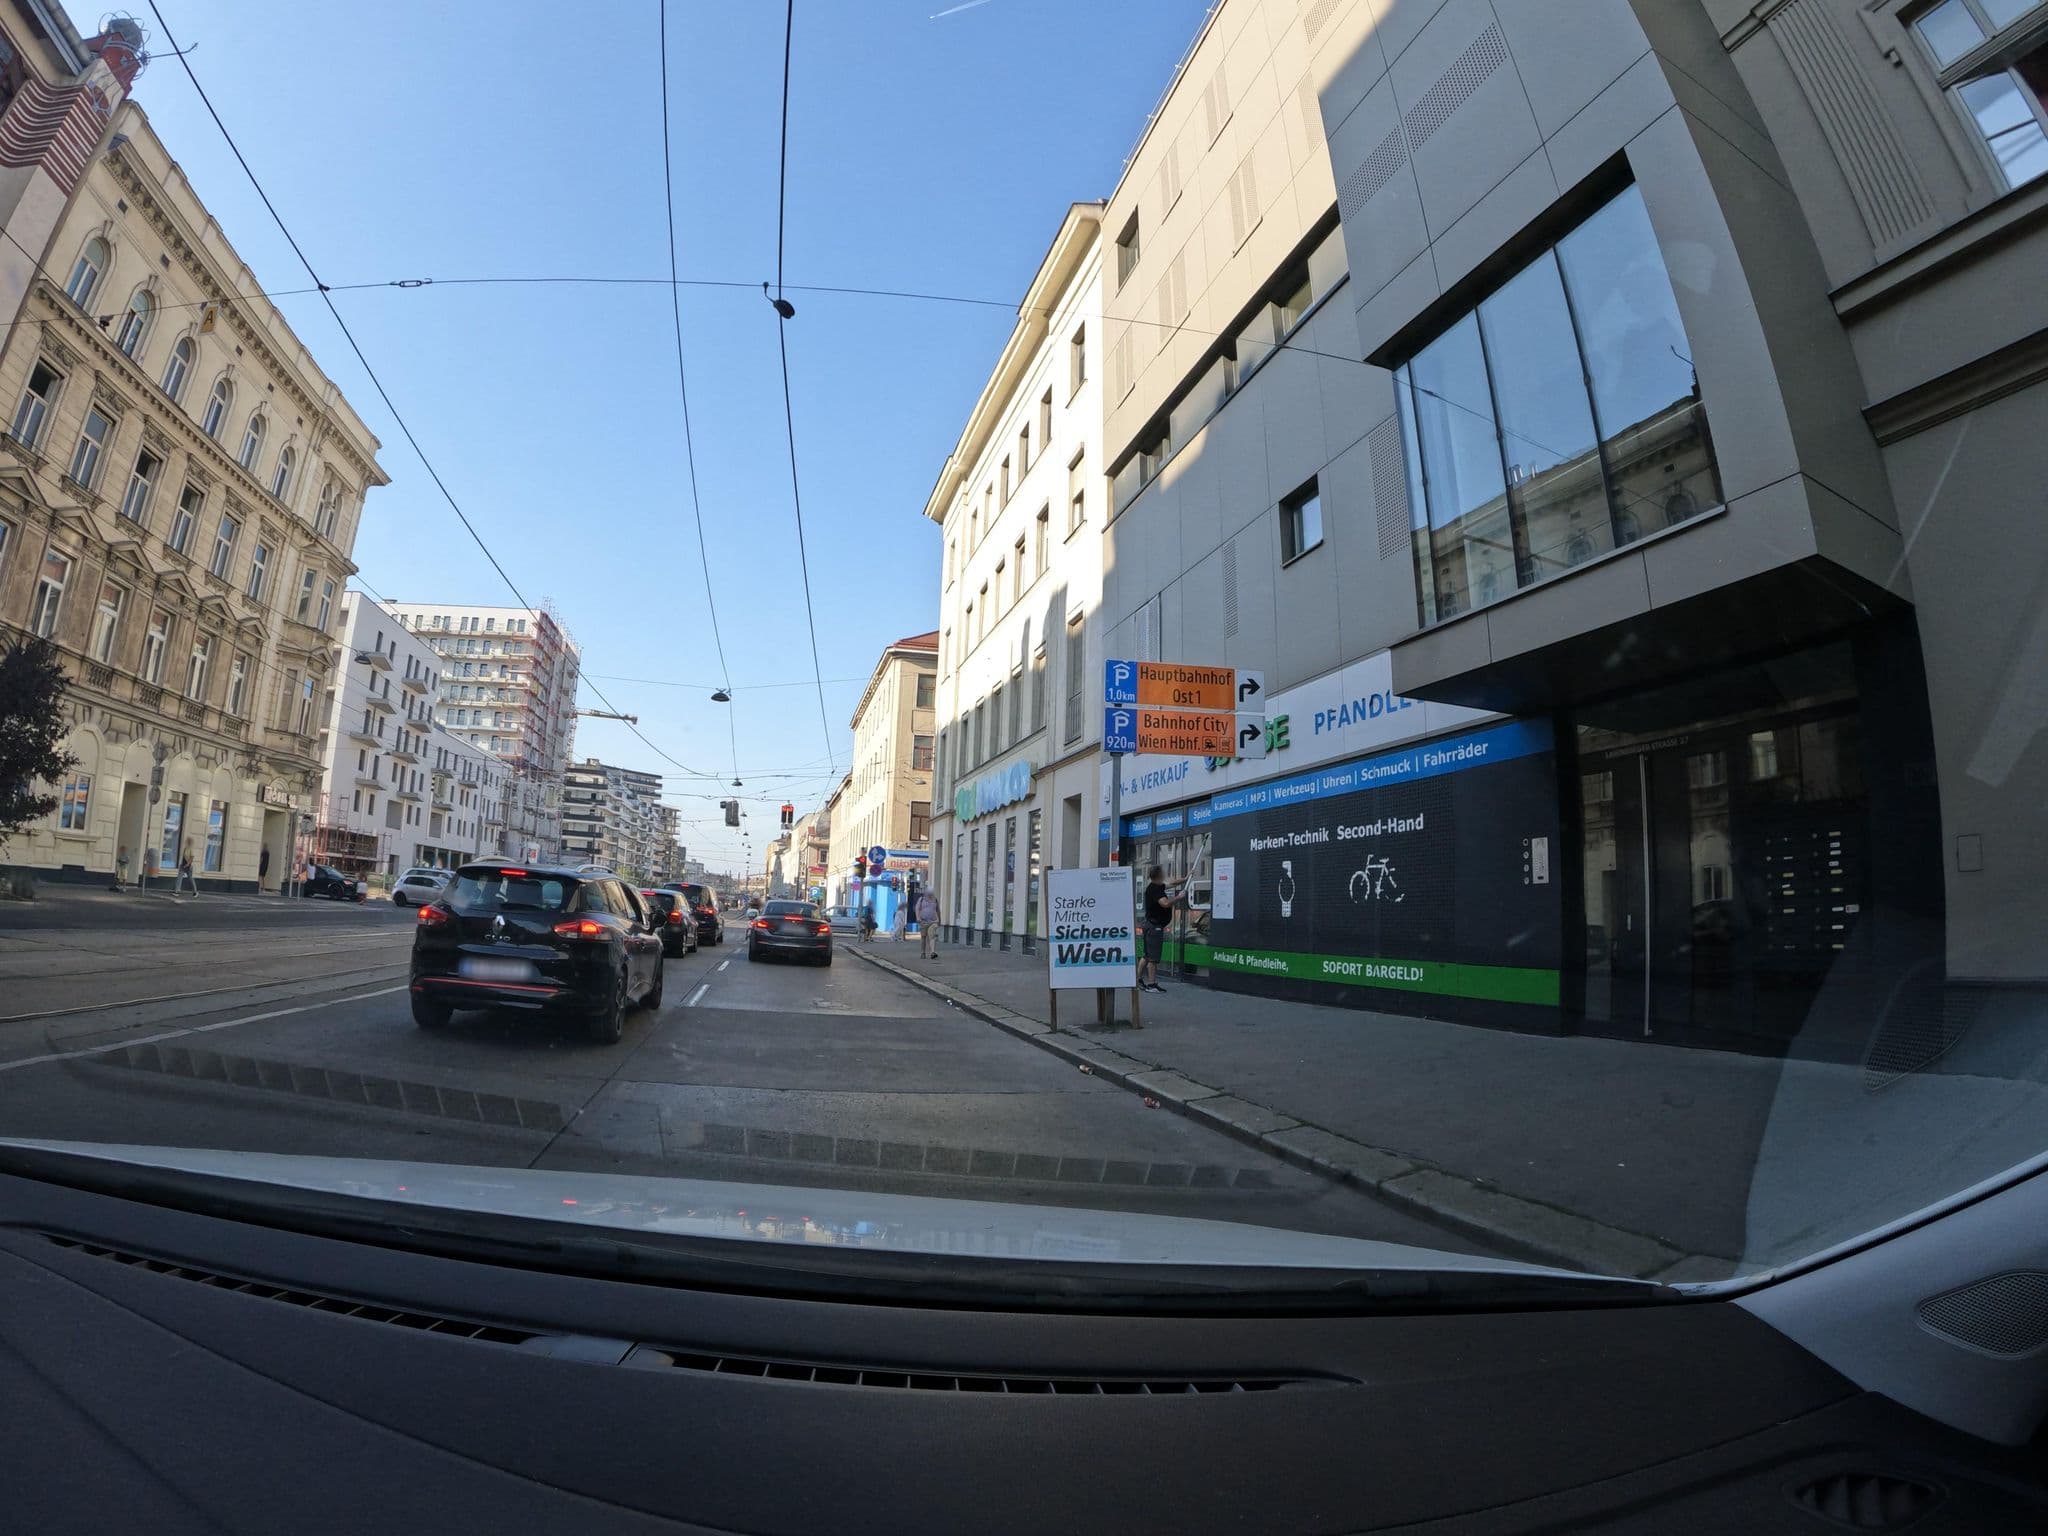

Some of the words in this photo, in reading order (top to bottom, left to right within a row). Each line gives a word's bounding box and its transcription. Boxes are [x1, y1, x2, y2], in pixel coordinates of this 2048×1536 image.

[1140, 665, 1233, 686] Hauptbahnhof
[1314, 689, 1424, 735] PFANDLE
[1144, 713, 1201, 731] Bahnhof
[1203, 717, 1229, 735] City
[1138, 734, 1167, 749] Wien
[1170, 734, 1201, 751] Hbhf.
[1131, 778, 1138, 794] &
[1140, 760, 1189, 791] VERKAUF
[1250, 790, 1266, 804] MP3
[1273, 781, 1316, 799] Werkzeug
[1323, 774, 1352, 789] Uhren
[1361, 758, 1411, 781] Schmuck
[1423, 742, 1489, 768] Fahrräder
[1250, 827, 1330, 851] Marken-Technik
[1336, 813, 1424, 840] Second-Hand
[1054, 896, 1096, 909] Starke
[1054, 910, 1093, 923] Mitte.
[1055, 924, 1128, 940] Sicheres
[1057, 942, 1129, 965] Wien.
[1213, 951, 1237, 964] Ankauf
[1238, 954, 1245, 965] &
[1322, 961, 1363, 976] SOFORT
[1366, 963, 1424, 981] BARGELD!
